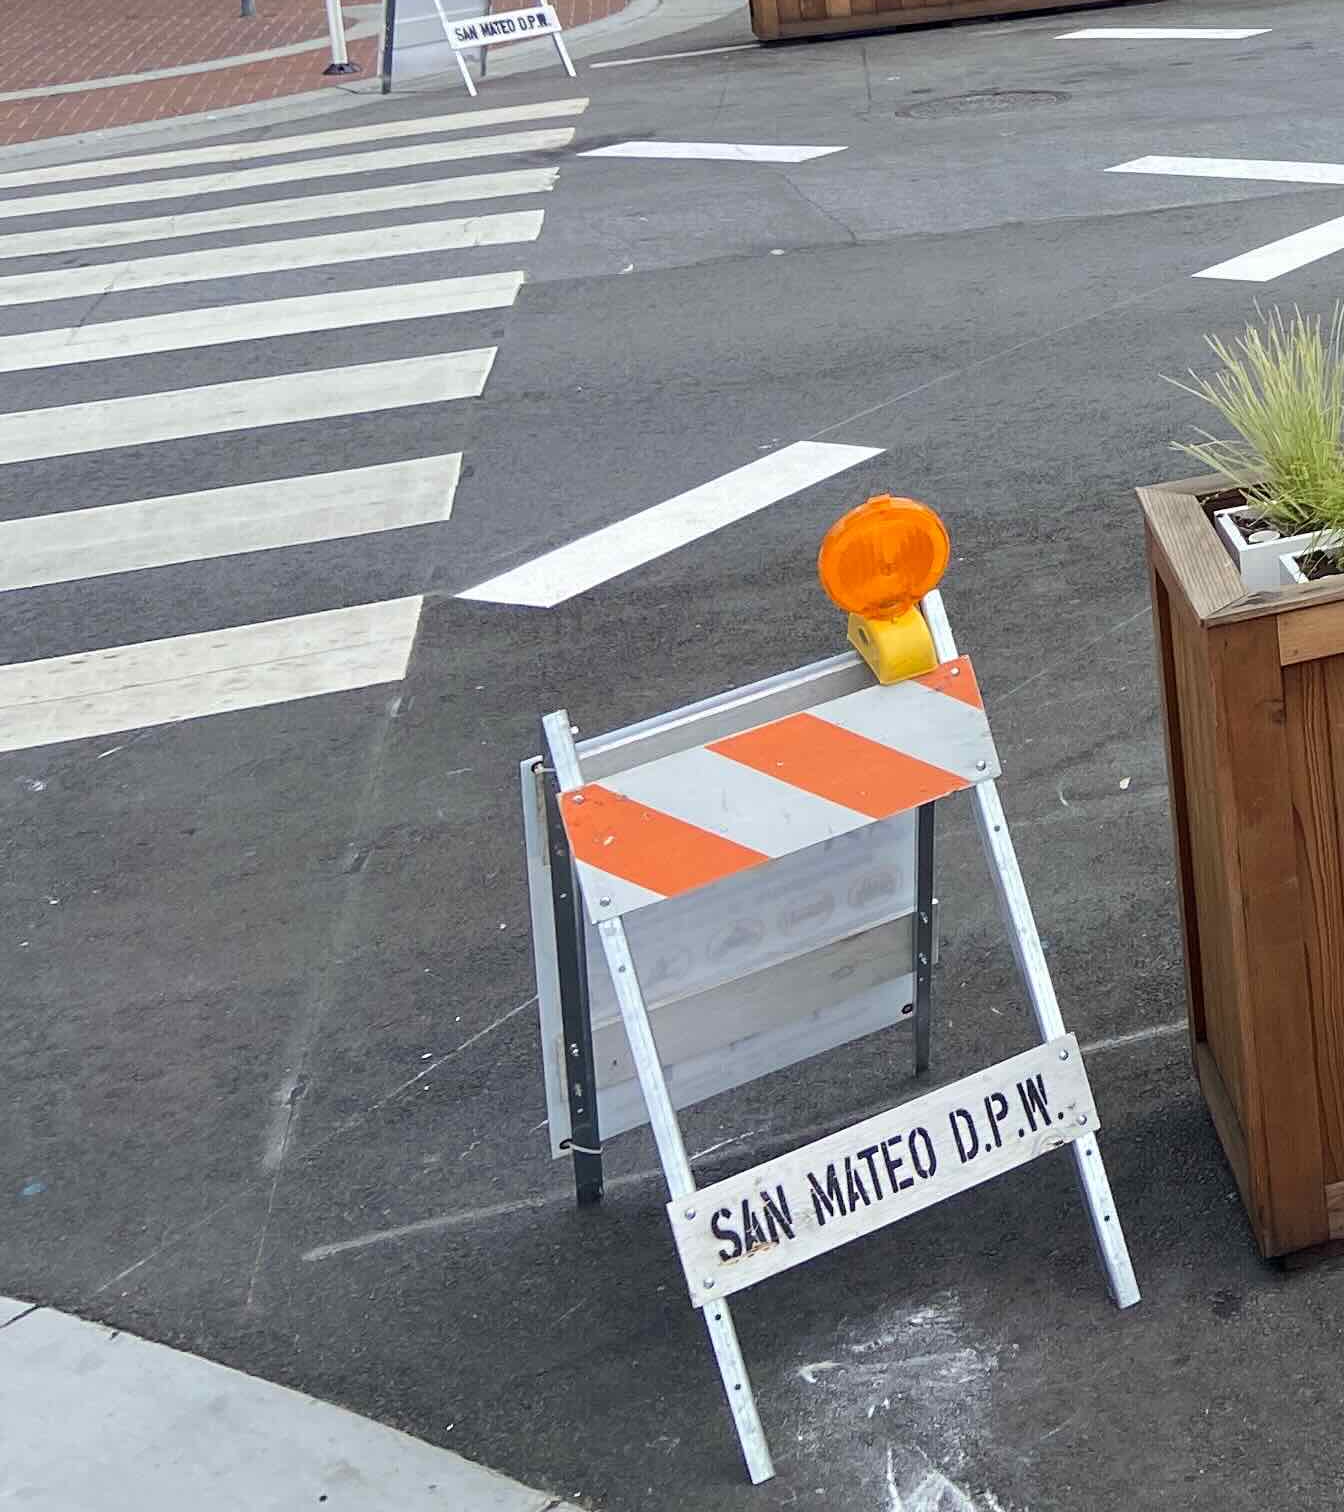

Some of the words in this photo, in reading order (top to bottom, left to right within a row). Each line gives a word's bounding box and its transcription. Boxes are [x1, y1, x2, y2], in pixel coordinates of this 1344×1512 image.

[455, 25, 479, 41] SAN
[480, 18, 516, 37] MATEO
[711, 1185, 796, 1261] SAN
[806, 1126, 937, 1226] MATEO
[949, 1073, 1064, 1164] D.P.W.
